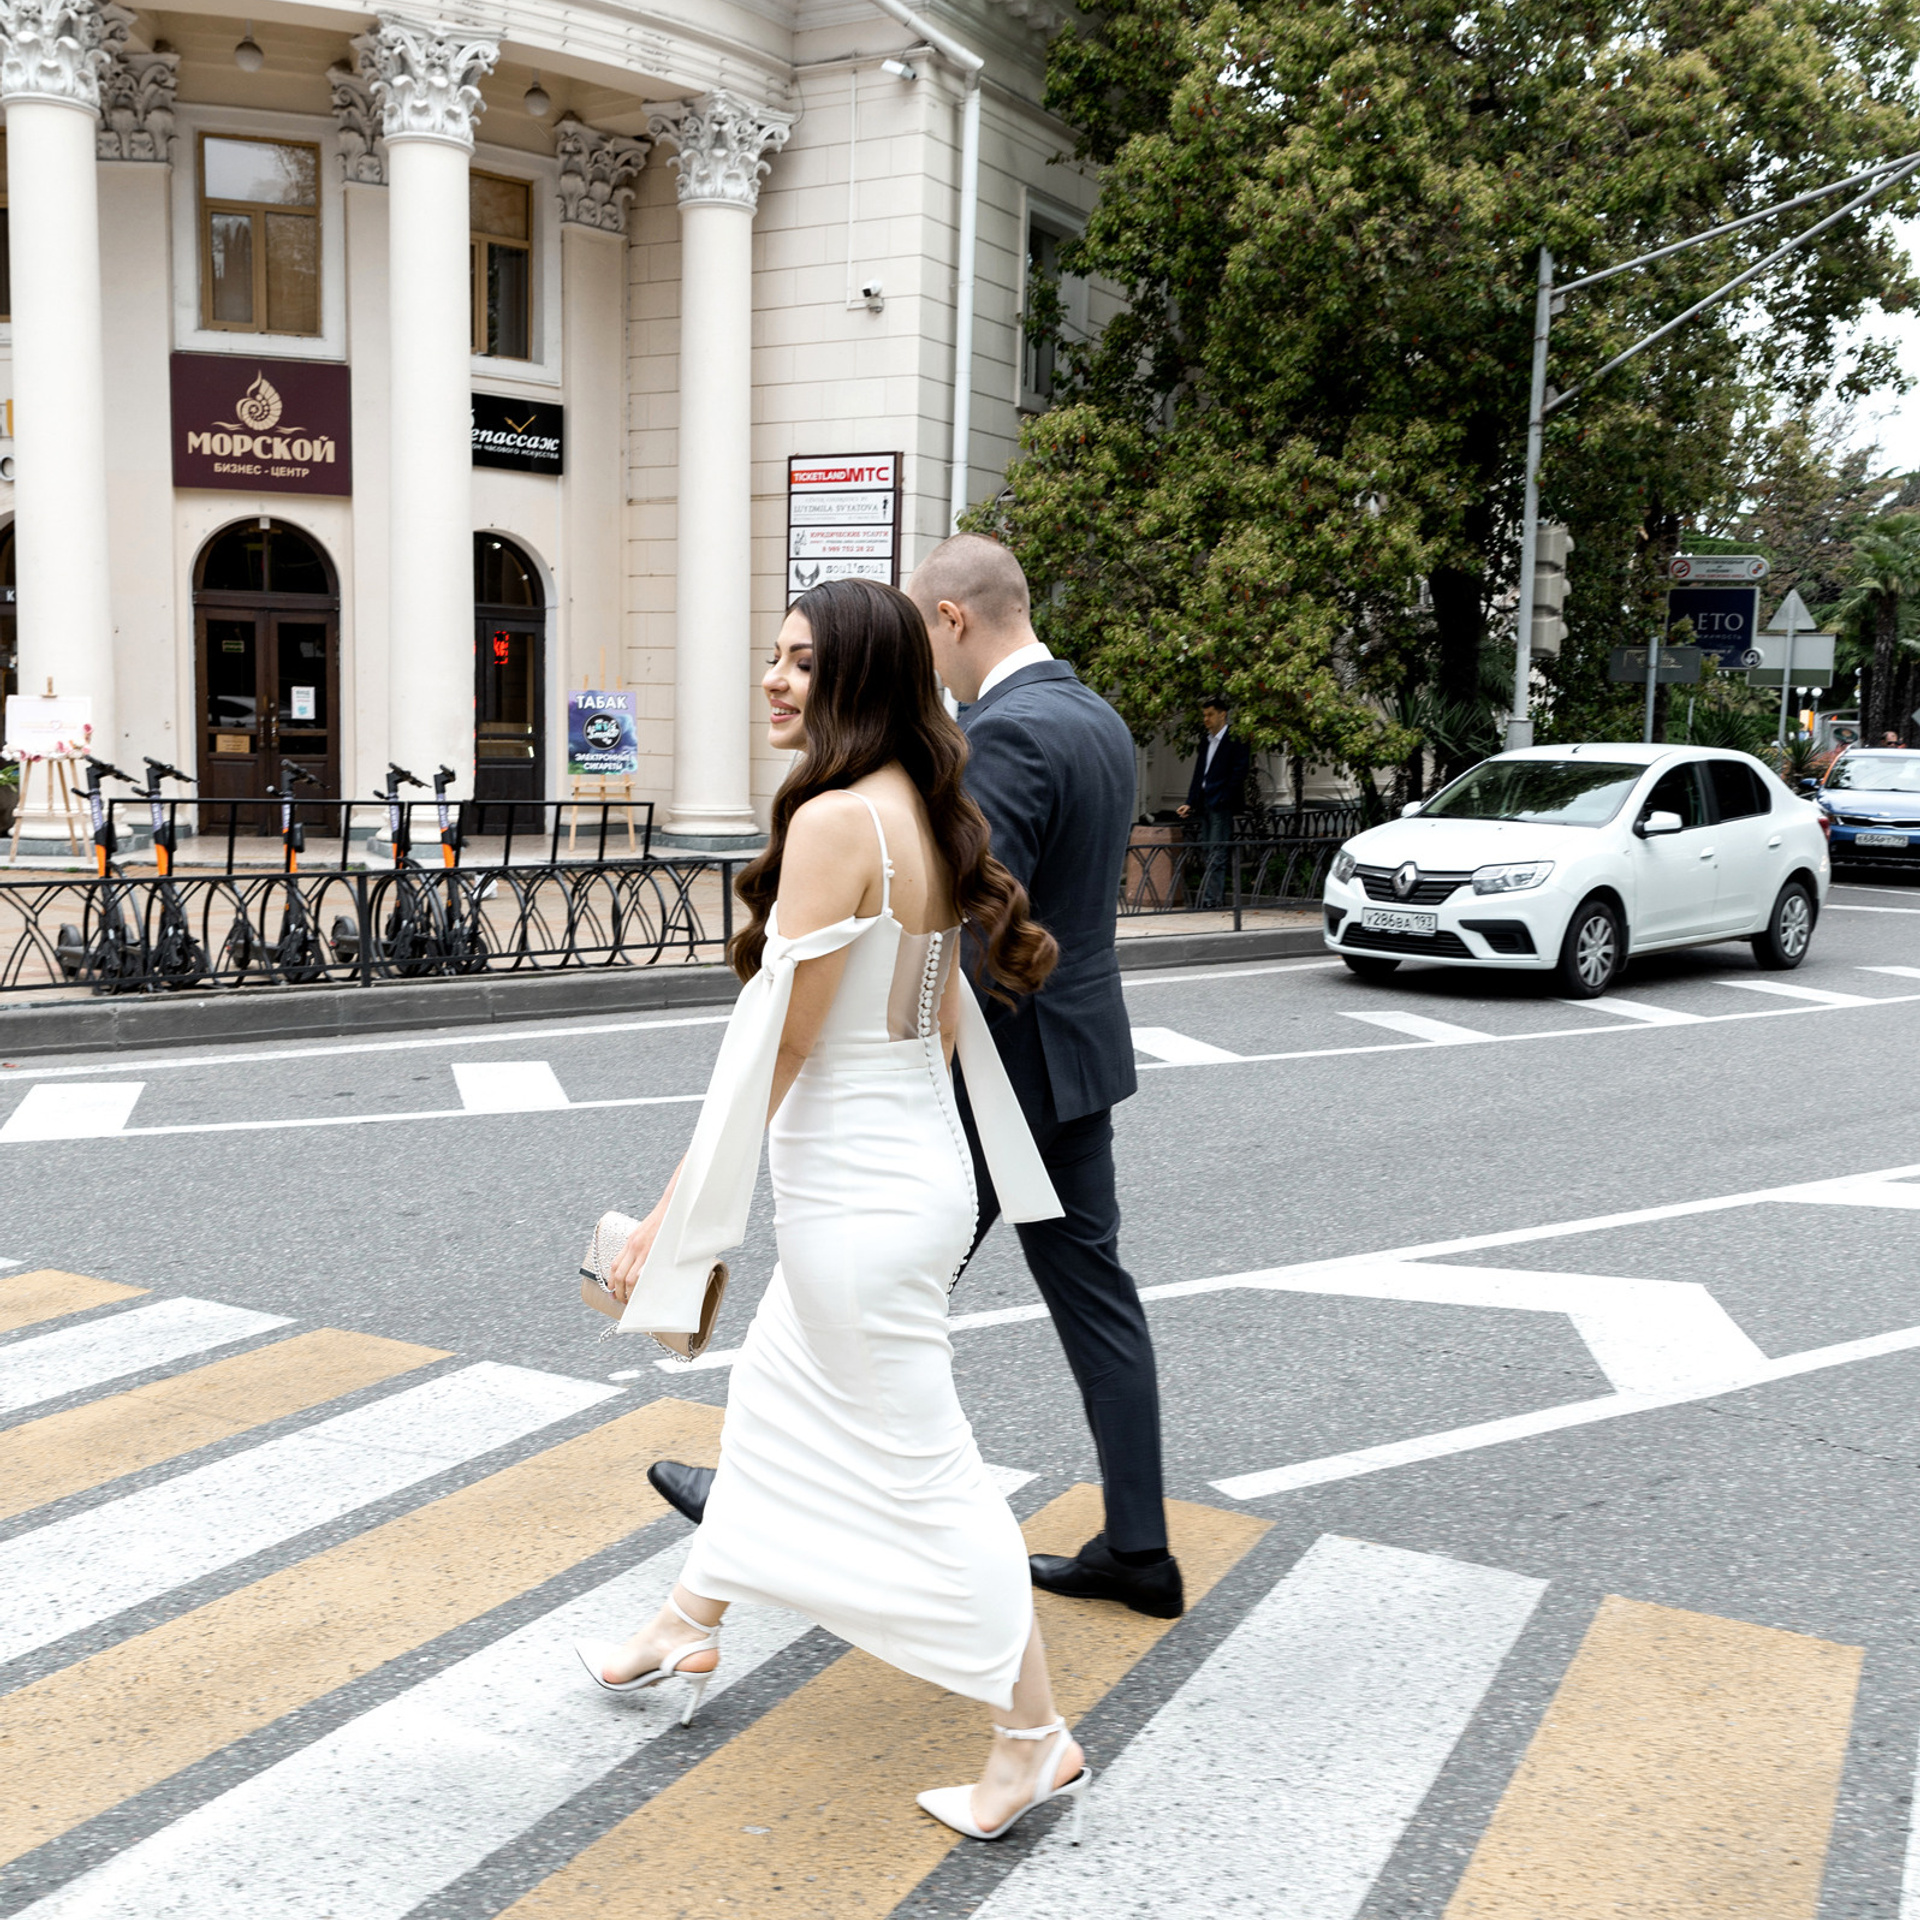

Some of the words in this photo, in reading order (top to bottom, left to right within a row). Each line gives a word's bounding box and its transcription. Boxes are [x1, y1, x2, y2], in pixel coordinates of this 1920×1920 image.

[187, 430, 336, 463] МОРСКОЙ
[213, 462, 262, 475] БИЗНЕС
[271, 466, 310, 478] ЦЕНТР
[1684, 612, 1744, 631] ЕТО
[576, 695, 628, 709] ТАБАК
[583, 762, 623, 770] СИГАРЕТЫ
